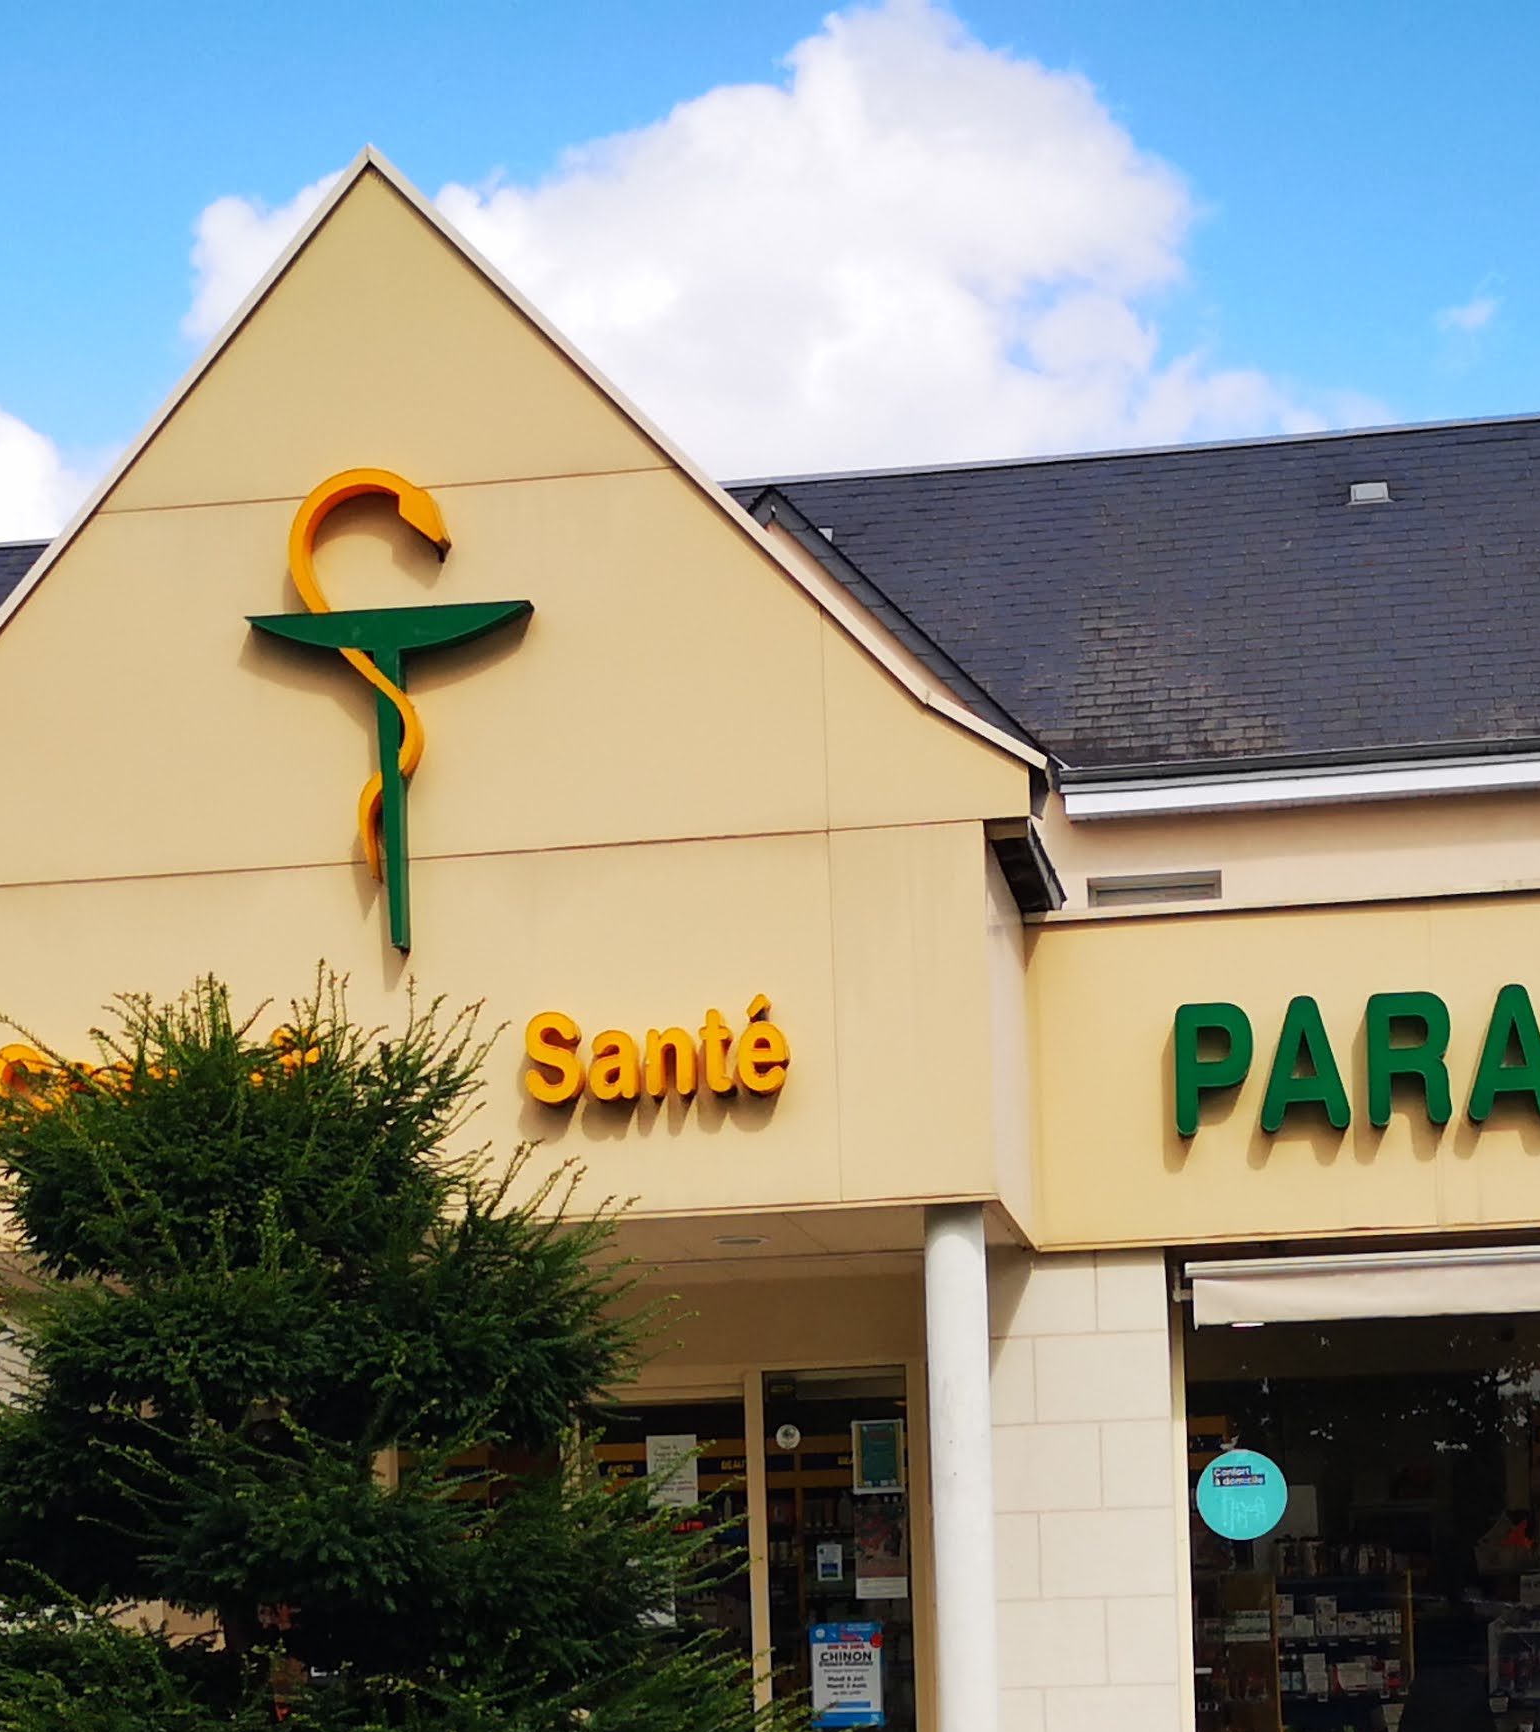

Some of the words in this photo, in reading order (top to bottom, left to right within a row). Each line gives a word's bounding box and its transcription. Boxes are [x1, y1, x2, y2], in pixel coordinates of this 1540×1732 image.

[523, 992, 793, 1106] Santé
[1214, 1468, 1250, 1476] Confort
[821, 1651, 872, 1661] CHINON
